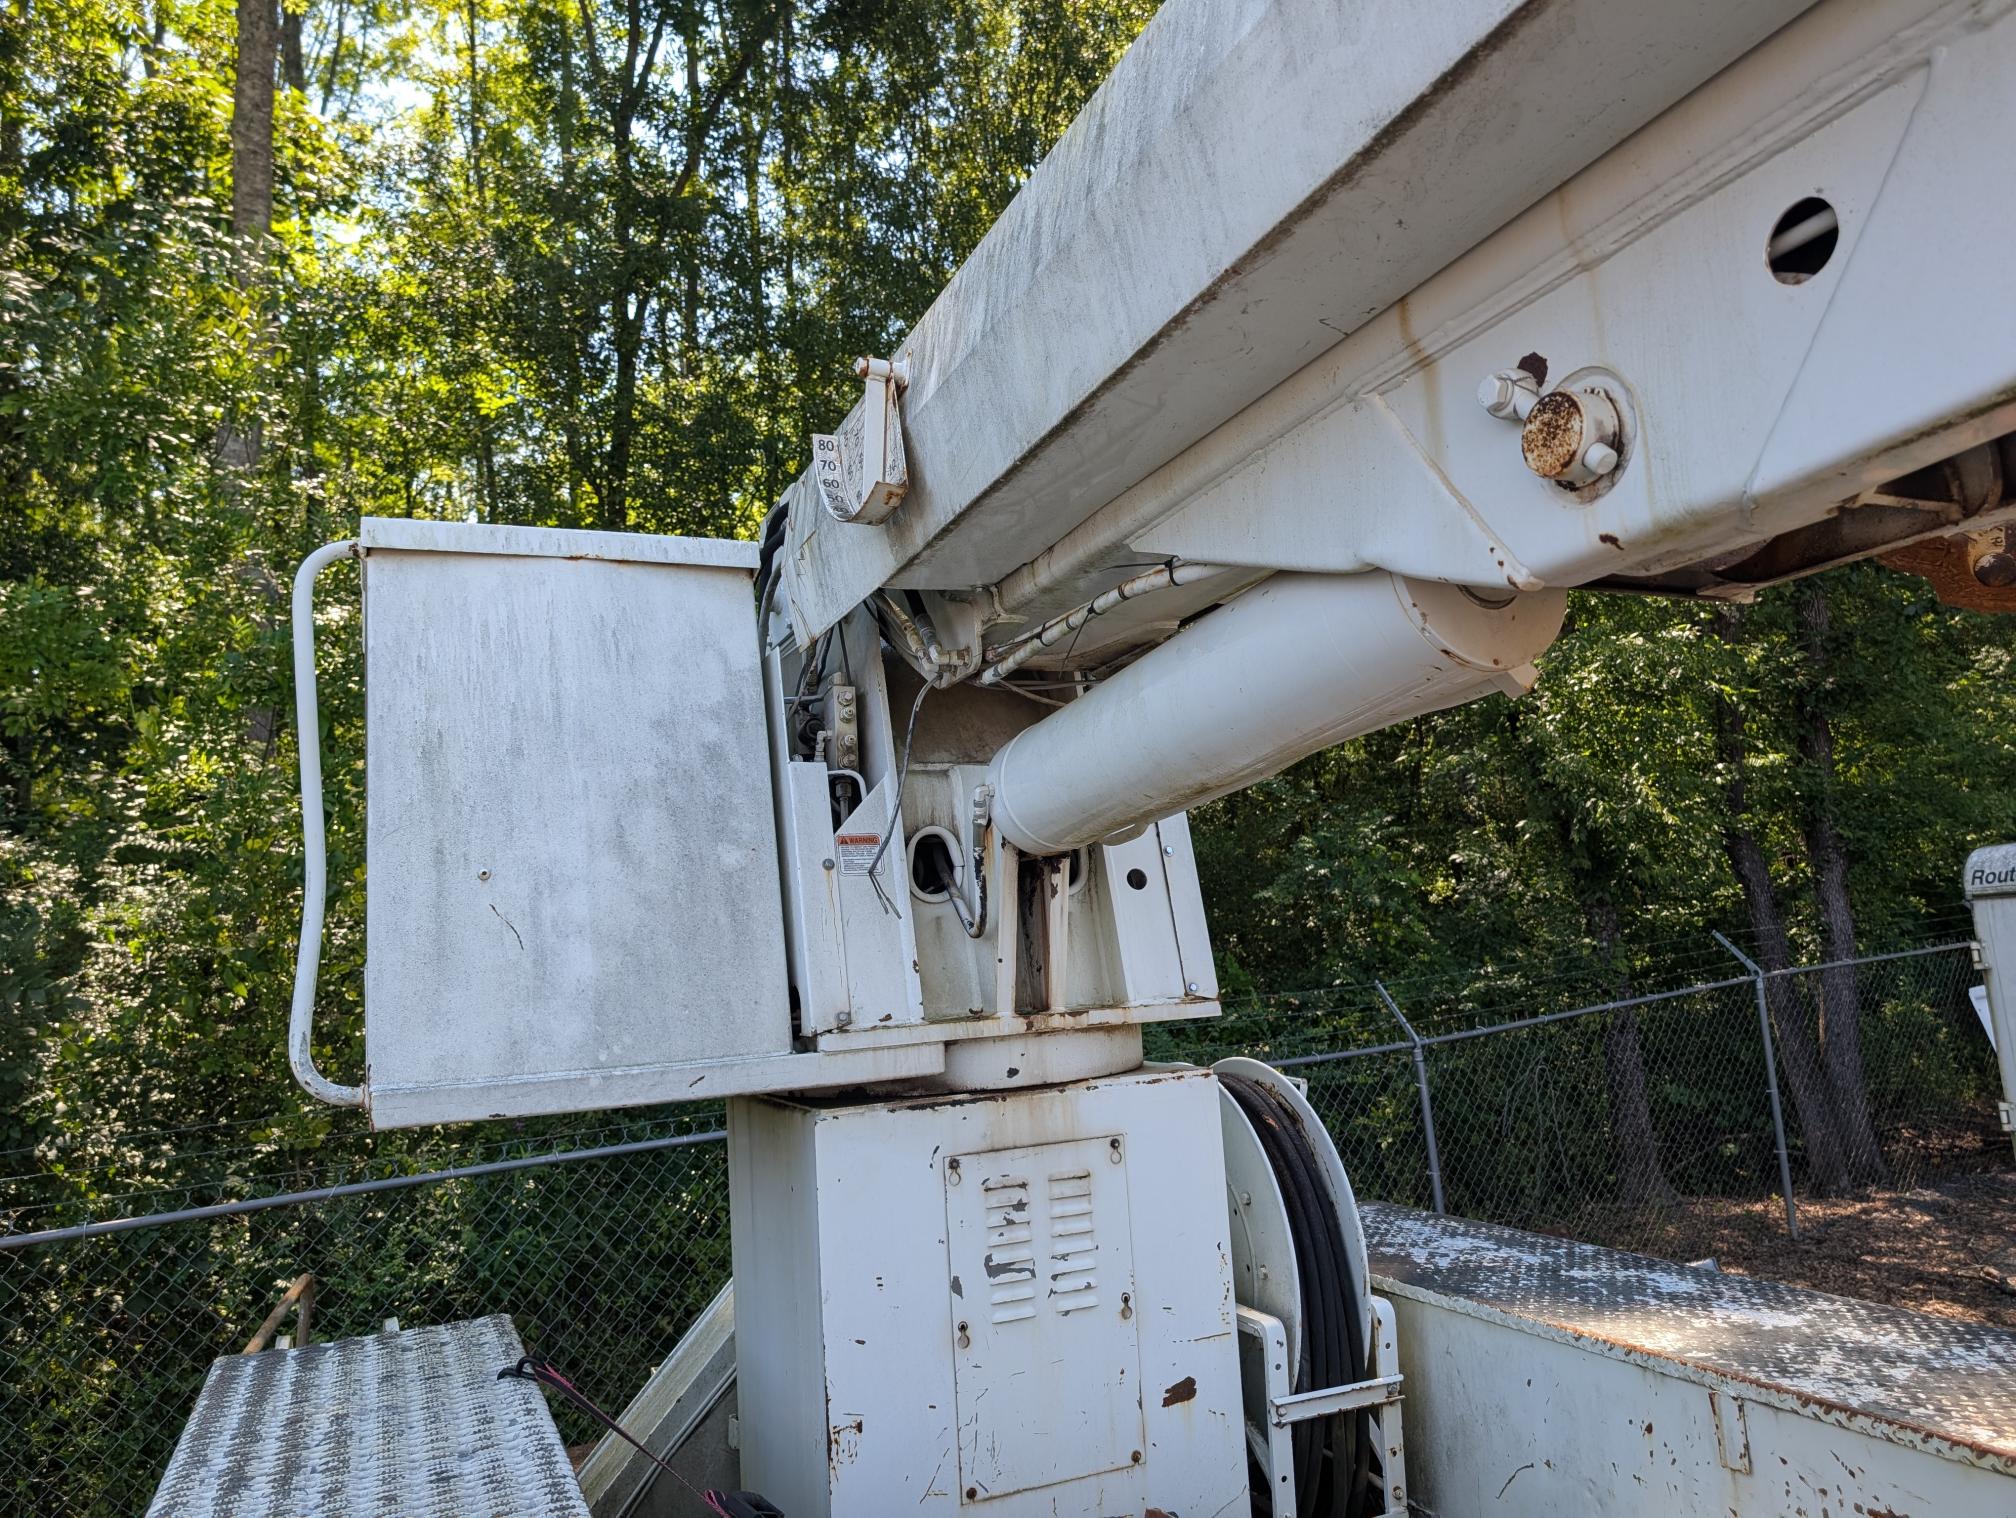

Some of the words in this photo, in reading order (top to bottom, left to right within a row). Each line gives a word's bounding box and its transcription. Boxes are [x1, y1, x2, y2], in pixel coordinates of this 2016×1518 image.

[818, 439, 834, 452] 80
[820, 460, 836, 471] 70
[823, 478, 839, 489] 60
[827, 494, 843, 503] 50
[1971, 866, 2016, 886] Rout
